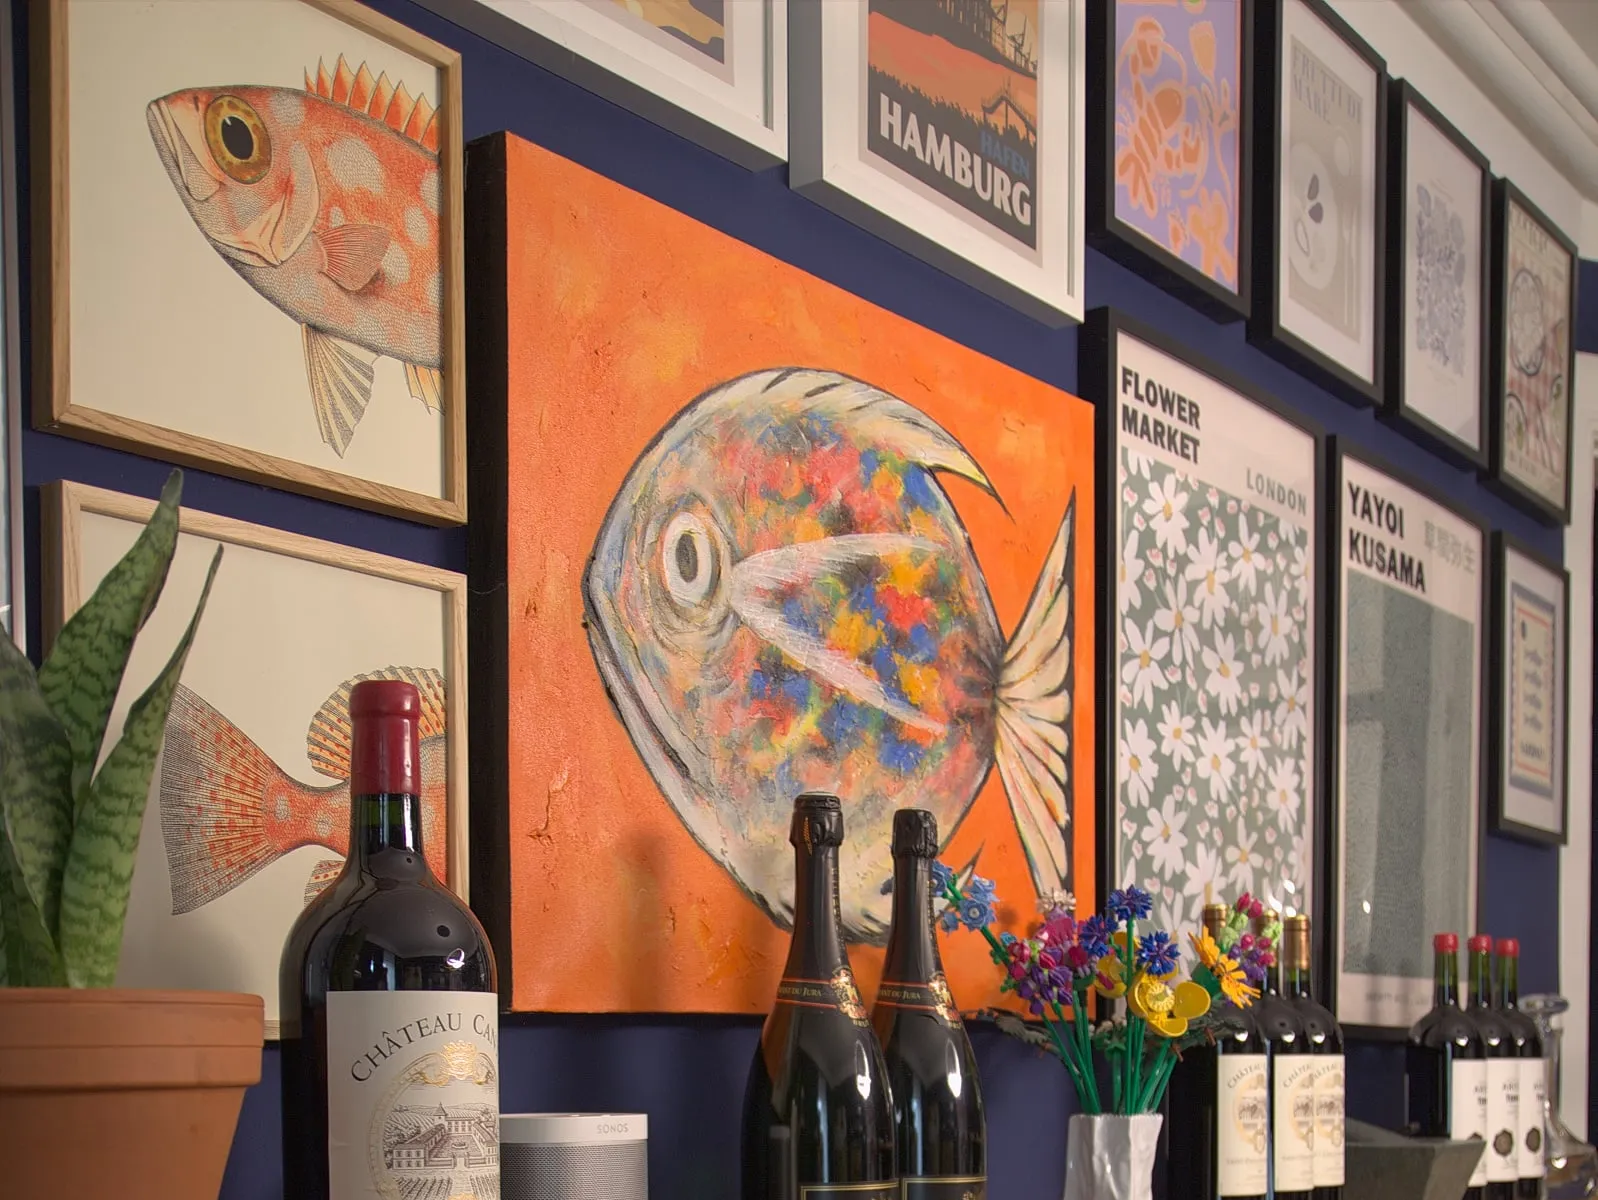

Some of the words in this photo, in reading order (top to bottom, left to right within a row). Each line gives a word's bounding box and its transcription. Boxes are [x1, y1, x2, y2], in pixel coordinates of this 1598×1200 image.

[879, 92, 1032, 226] HAMBURG
[981, 129, 1030, 180] HAFEN
[1121, 366, 1201, 431] FLOWER
[1121, 404, 1201, 466] MARKET
[1246, 468, 1307, 517] LONDON
[1348, 481, 1405, 541] YAYOI
[1348, 528, 1427, 594] KUSAMA
[802, 987, 822, 997] JURA
[351, 1012, 462, 1082] CHÂTEAU
[596, 1123, 629, 1134] SONOS
